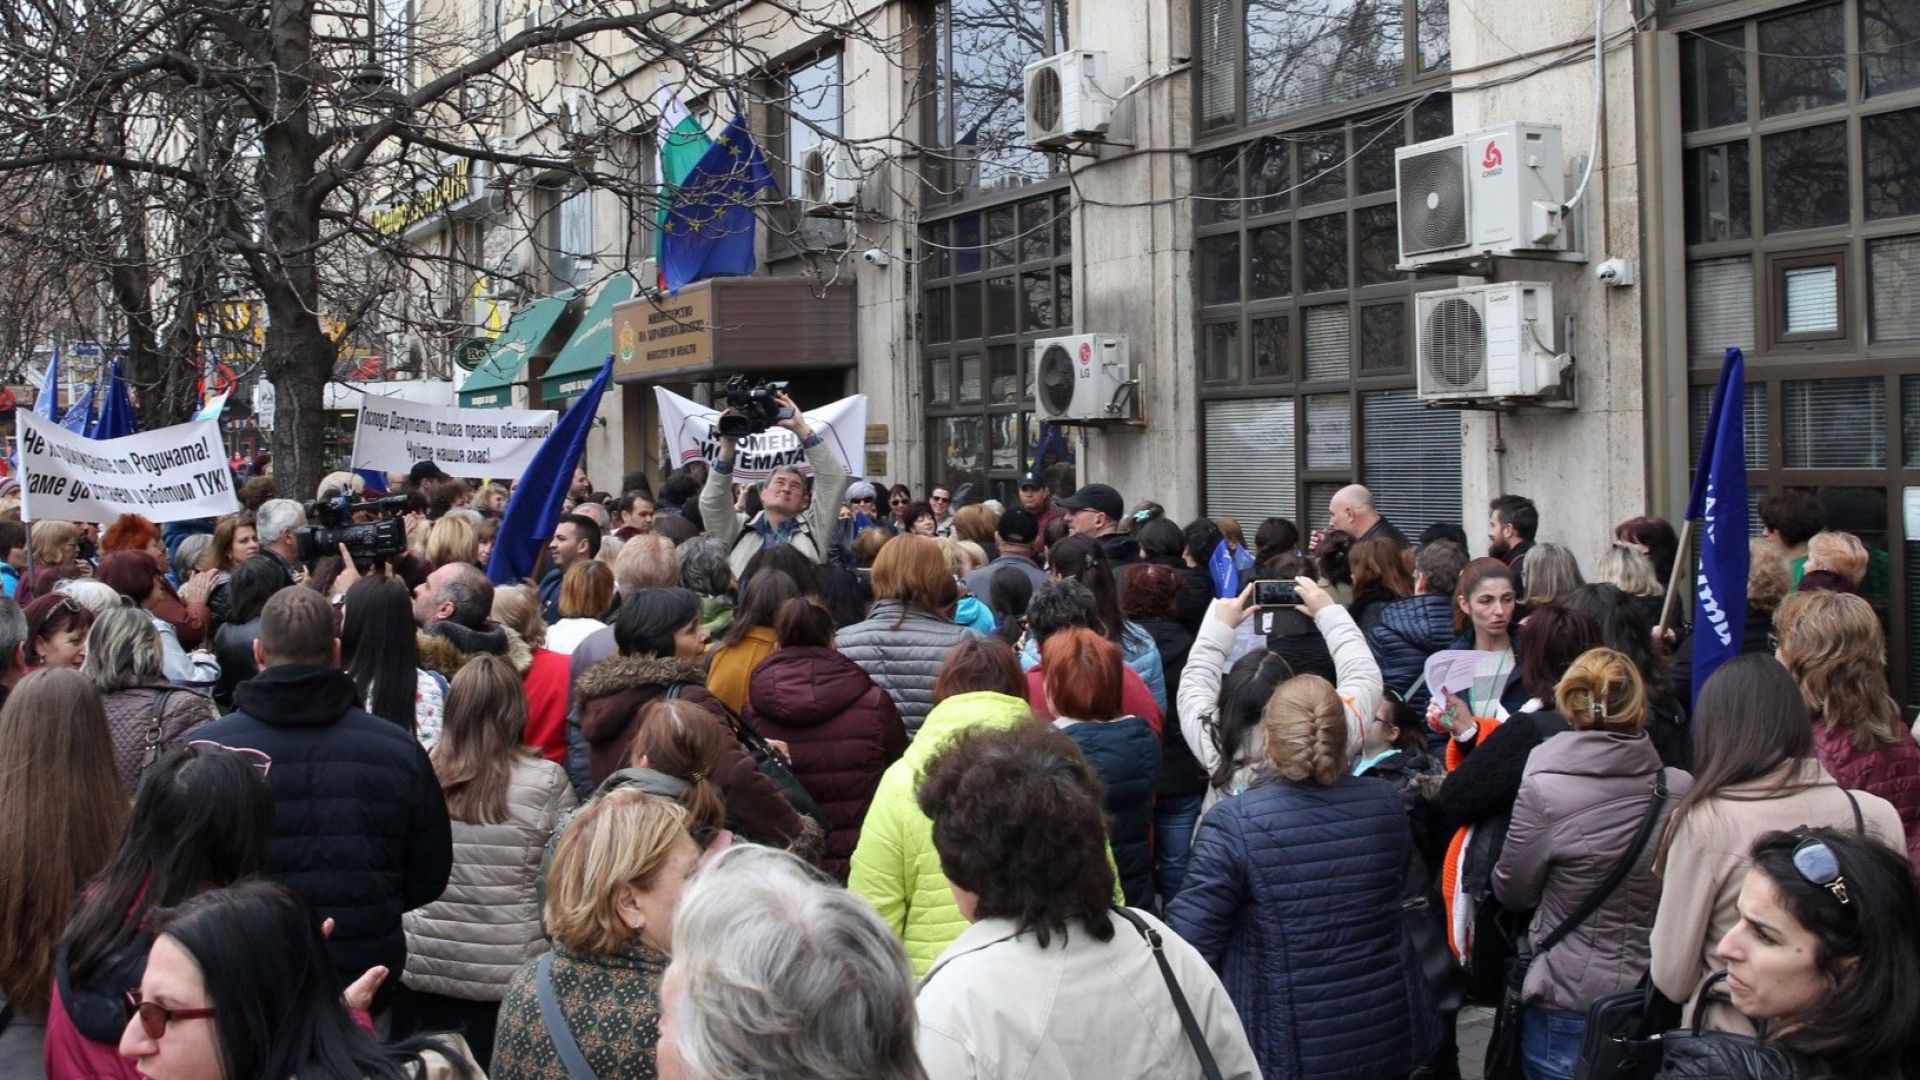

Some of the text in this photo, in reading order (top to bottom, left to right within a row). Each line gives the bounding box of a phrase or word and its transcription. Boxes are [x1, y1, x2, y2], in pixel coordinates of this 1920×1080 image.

[1079, 368, 1091, 379] LG
[360, 406, 388, 431] Господа
[436, 421, 464, 437] стига
[465, 422, 498, 441] празни
[501, 421, 554, 440] обещания!
[24, 427, 46, 455] Не
[129, 436, 212, 477] Родината!
[406, 440, 491, 464] Чуйте нашия глас!
[193, 468, 229, 498] ТУК!
